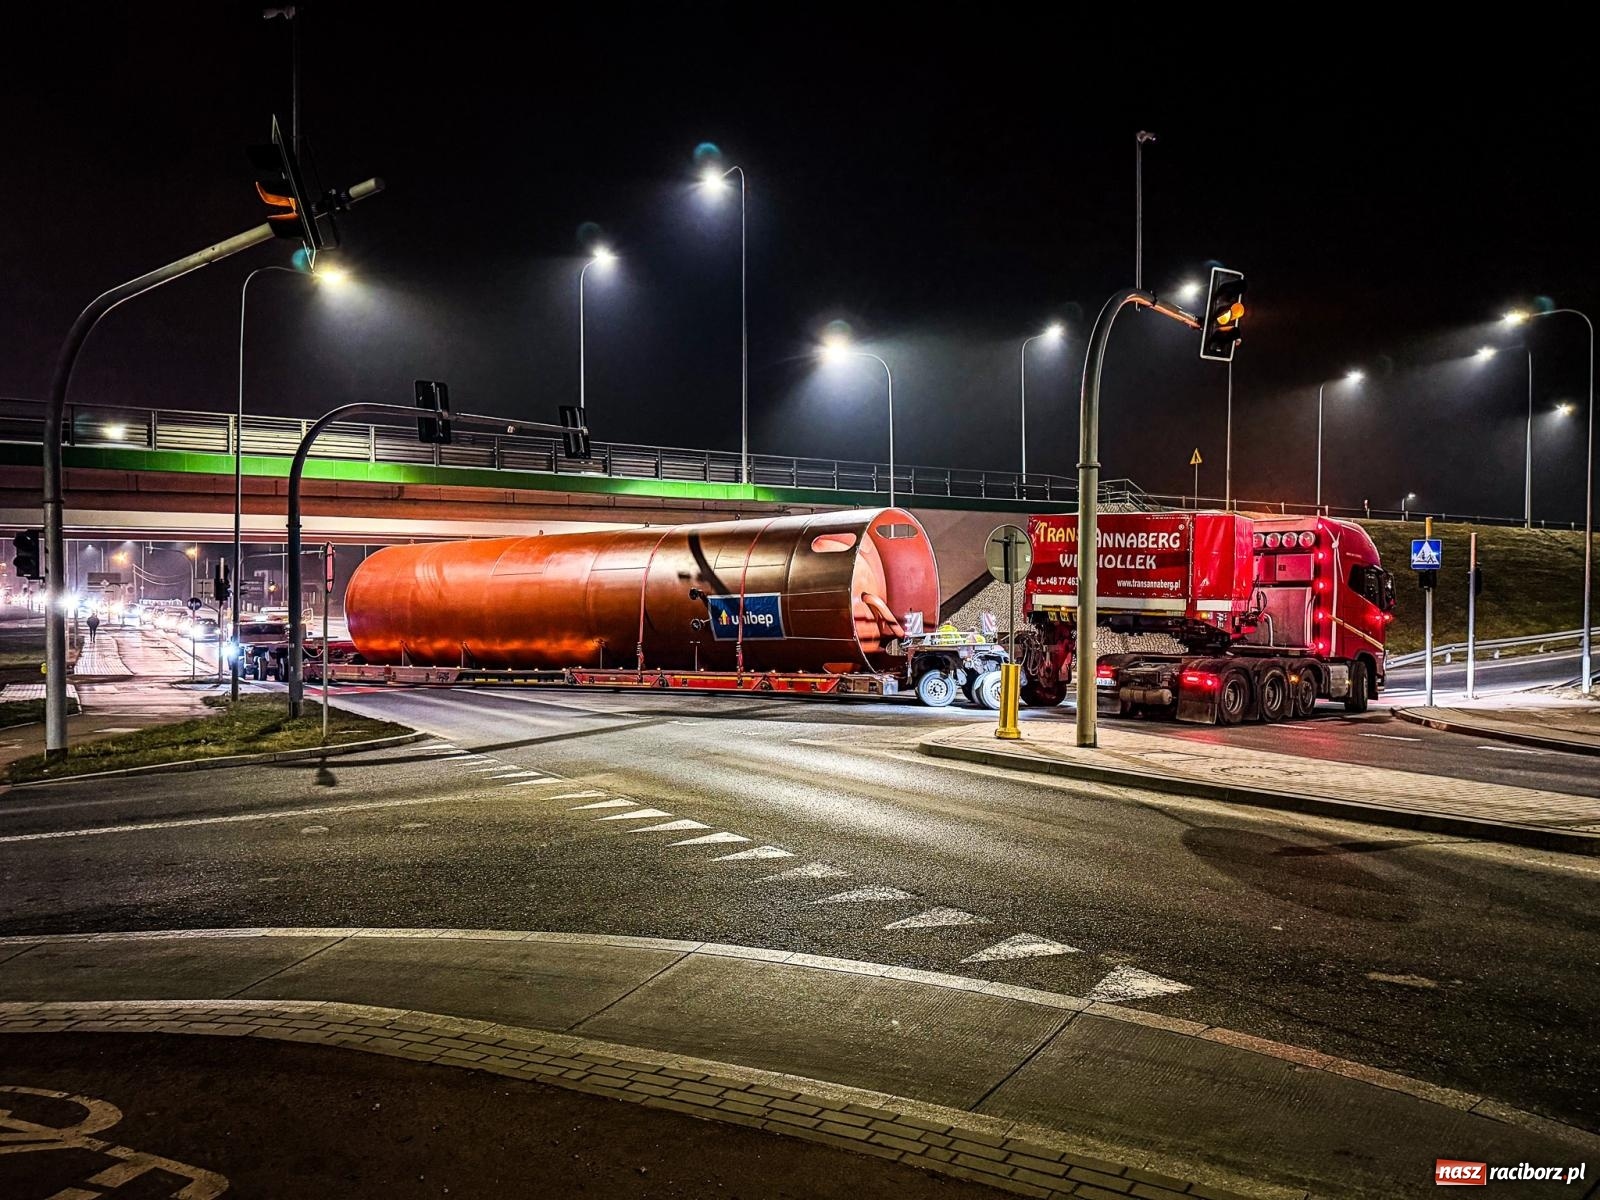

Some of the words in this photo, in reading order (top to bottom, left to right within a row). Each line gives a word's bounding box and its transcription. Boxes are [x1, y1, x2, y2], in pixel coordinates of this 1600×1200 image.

[1035, 521, 1079, 543] TRAN
[1059, 553, 1157, 570] WIIOLLEK
[1116, 579, 1181, 591] www.transannaberg.pl
[731, 611, 774, 628] unibep
